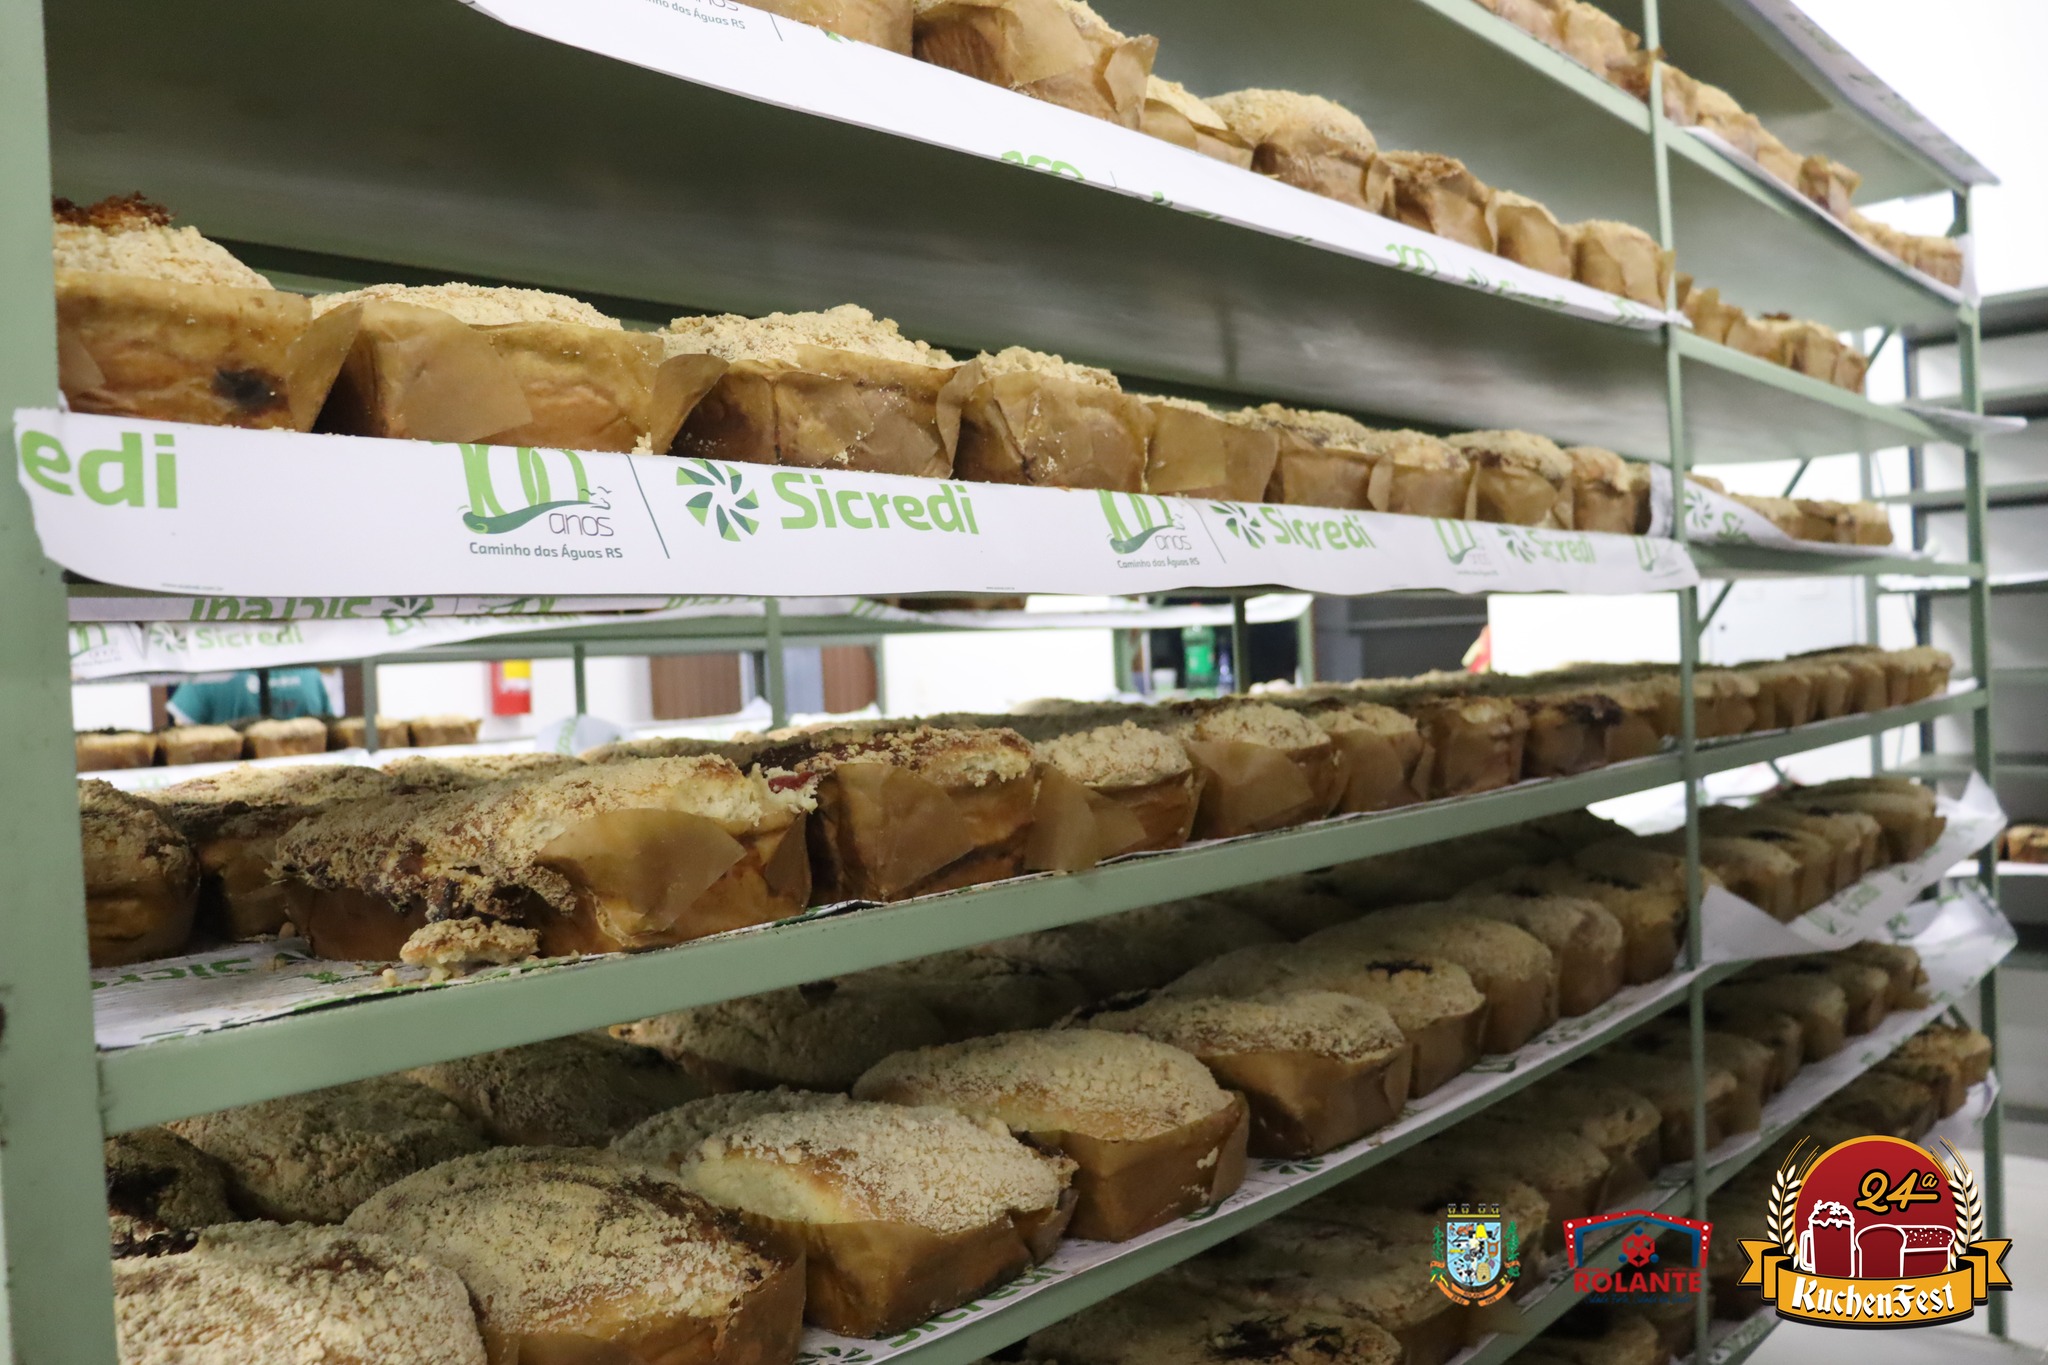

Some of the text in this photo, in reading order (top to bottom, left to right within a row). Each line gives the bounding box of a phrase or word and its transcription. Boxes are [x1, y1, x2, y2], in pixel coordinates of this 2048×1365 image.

[731, 18, 746, 30] RS
[771, 471, 980, 535] Sicredi
[549, 513, 615, 537] anos
[1258, 505, 1377, 551] Sicredi
[469, 541, 623, 561] Caminho das Águas RS
